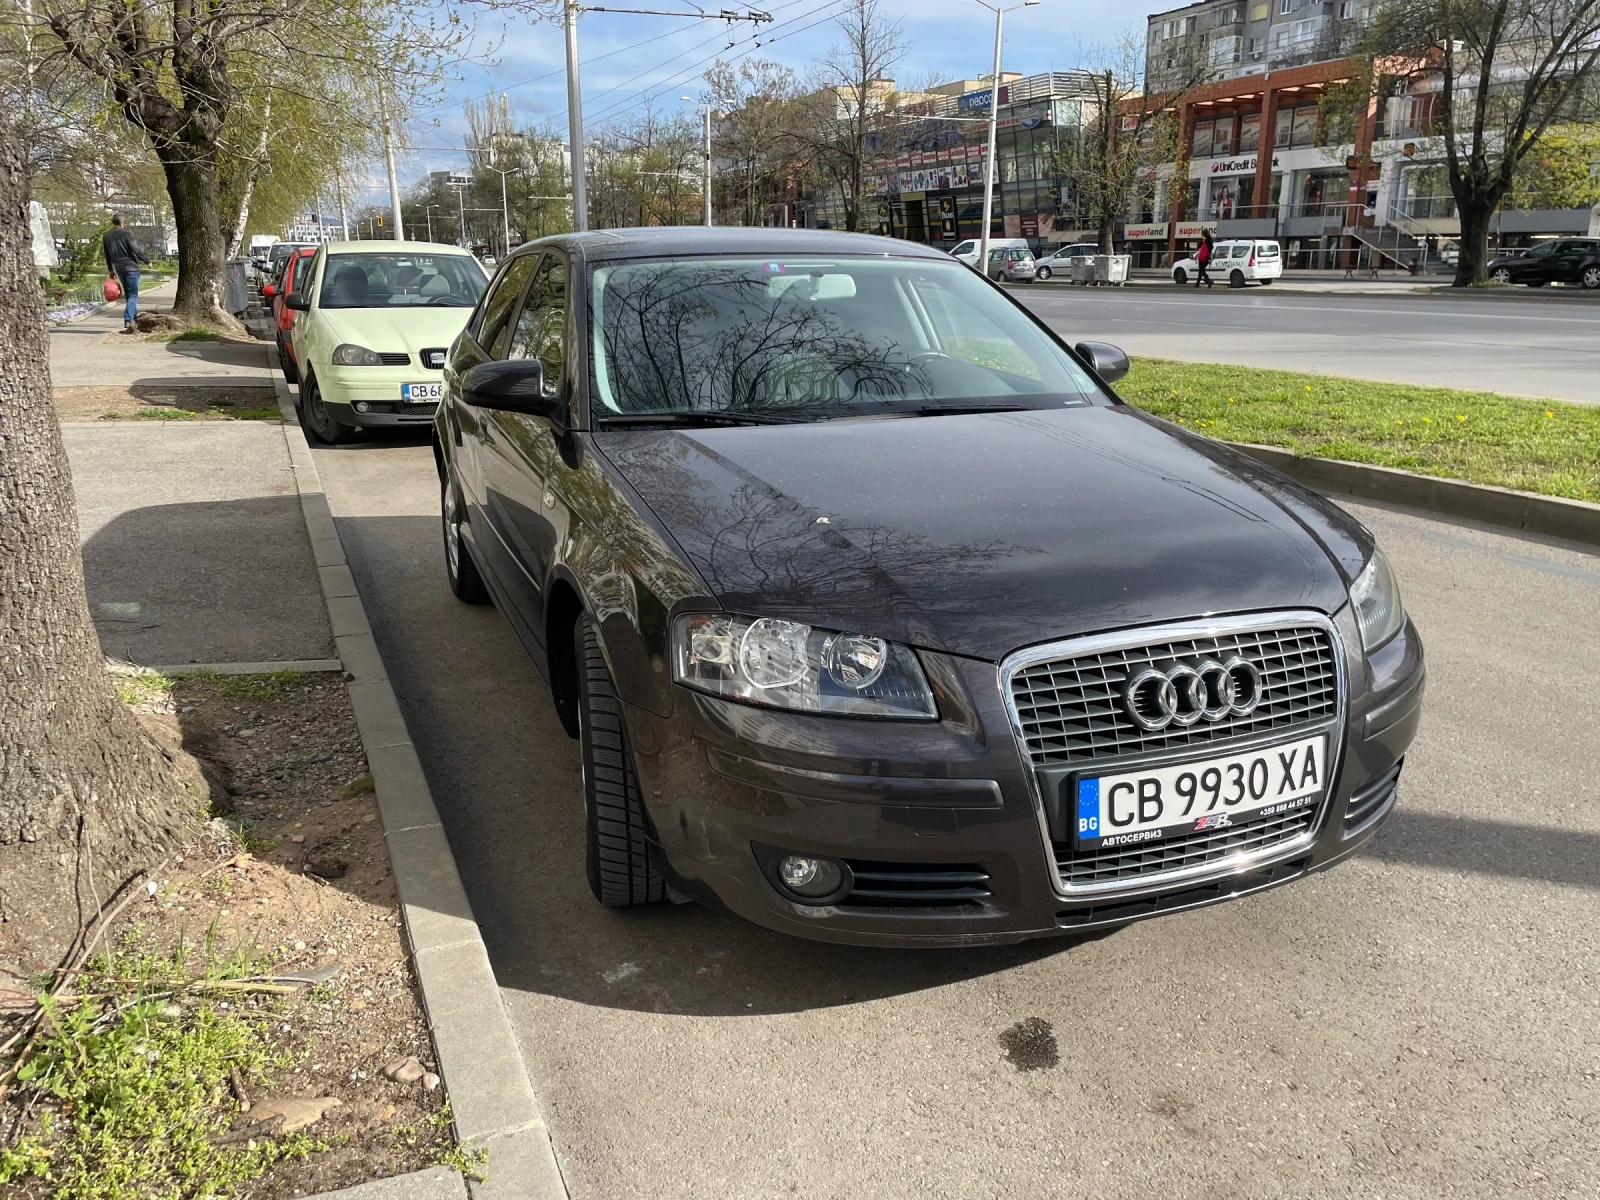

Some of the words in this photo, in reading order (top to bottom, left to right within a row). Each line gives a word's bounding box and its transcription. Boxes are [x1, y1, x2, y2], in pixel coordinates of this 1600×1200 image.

[1219, 160, 1250, 172] UniCredit
[1127, 226, 1164, 238] superland
[411, 386, 428, 397] CB
[1108, 777, 1164, 827] CB
[1175, 757, 1269, 817] 9930
[1277, 744, 1319, 797] XA
[1259, 806, 1275, 816] +359
[1079, 816, 1098, 832] BG
[1101, 829, 1163, 847] АВТОСЕРВИЗ
